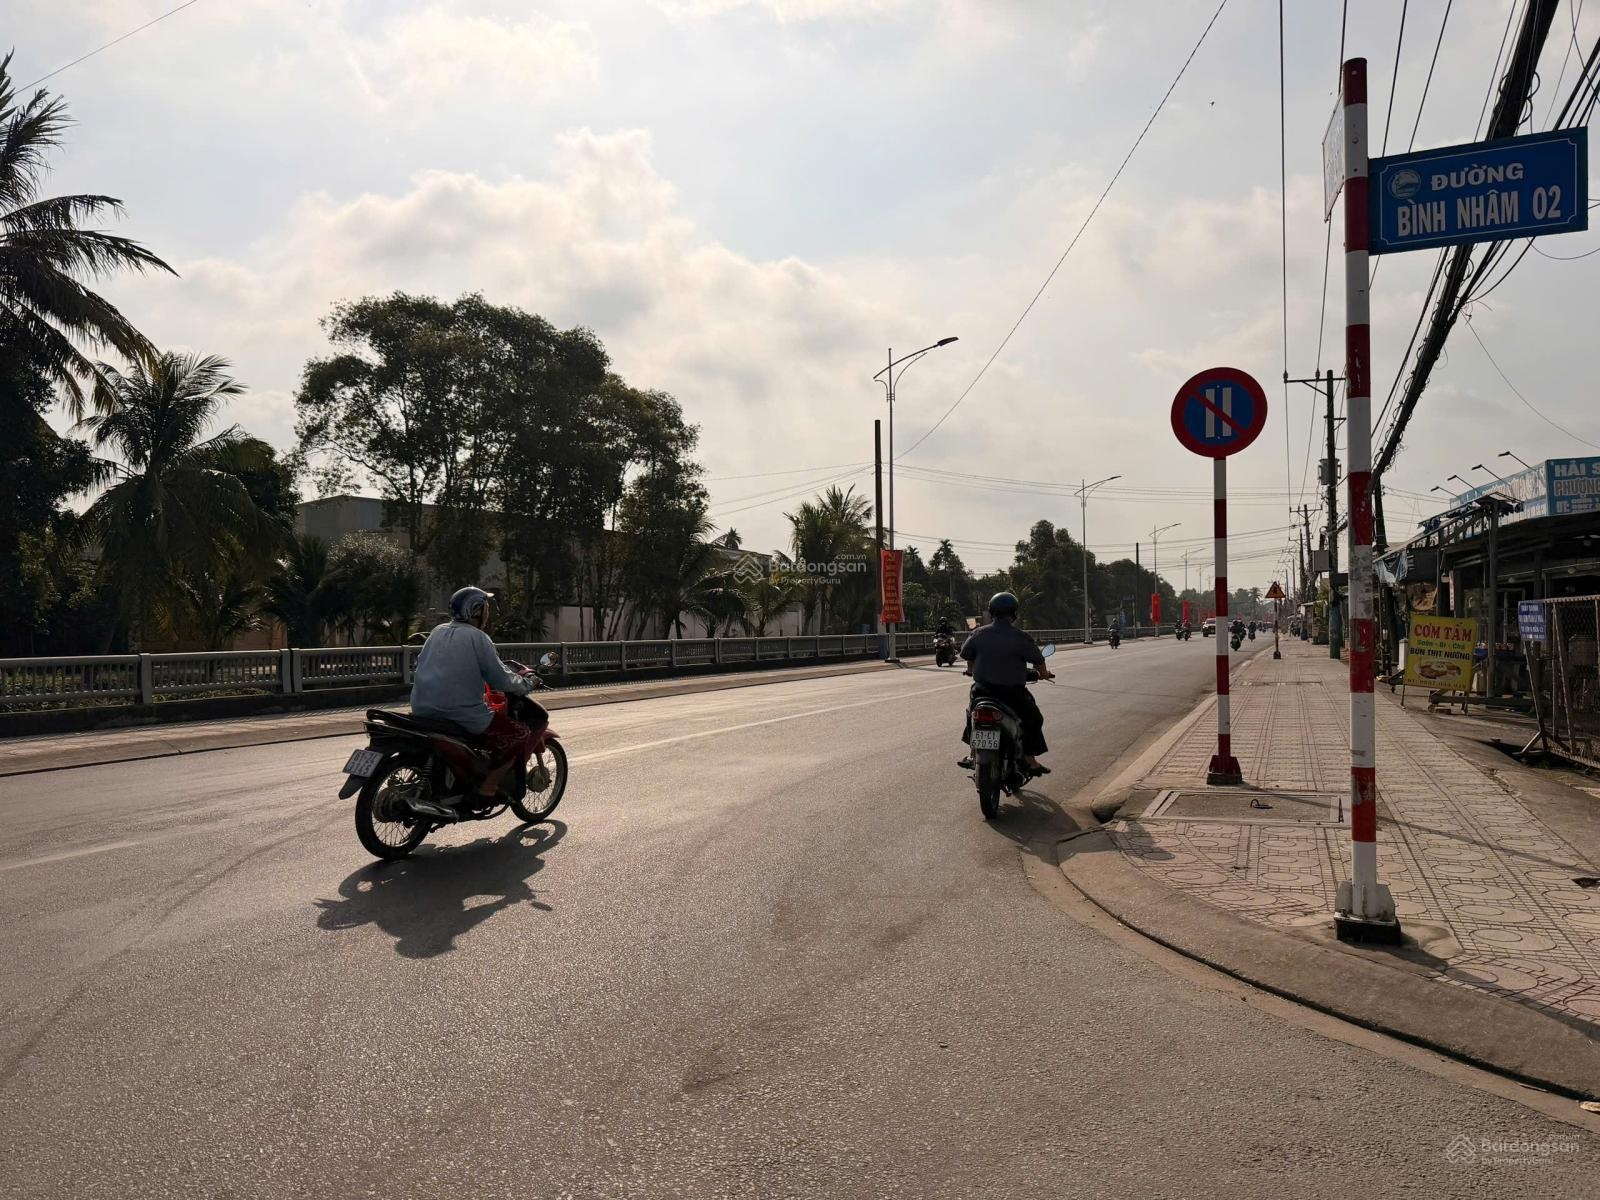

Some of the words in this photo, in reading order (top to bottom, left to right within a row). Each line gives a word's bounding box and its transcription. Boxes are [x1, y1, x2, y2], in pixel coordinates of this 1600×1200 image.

[1431, 163, 1524, 191] ĐƯỜNG
[1398, 199, 1446, 237] BÌNH
[1457, 189, 1519, 229] NHÂM
[1532, 185, 1561, 220] 02
[1414, 623, 1440, 639] CƠM
[1444, 622, 1472, 642] TẤM
